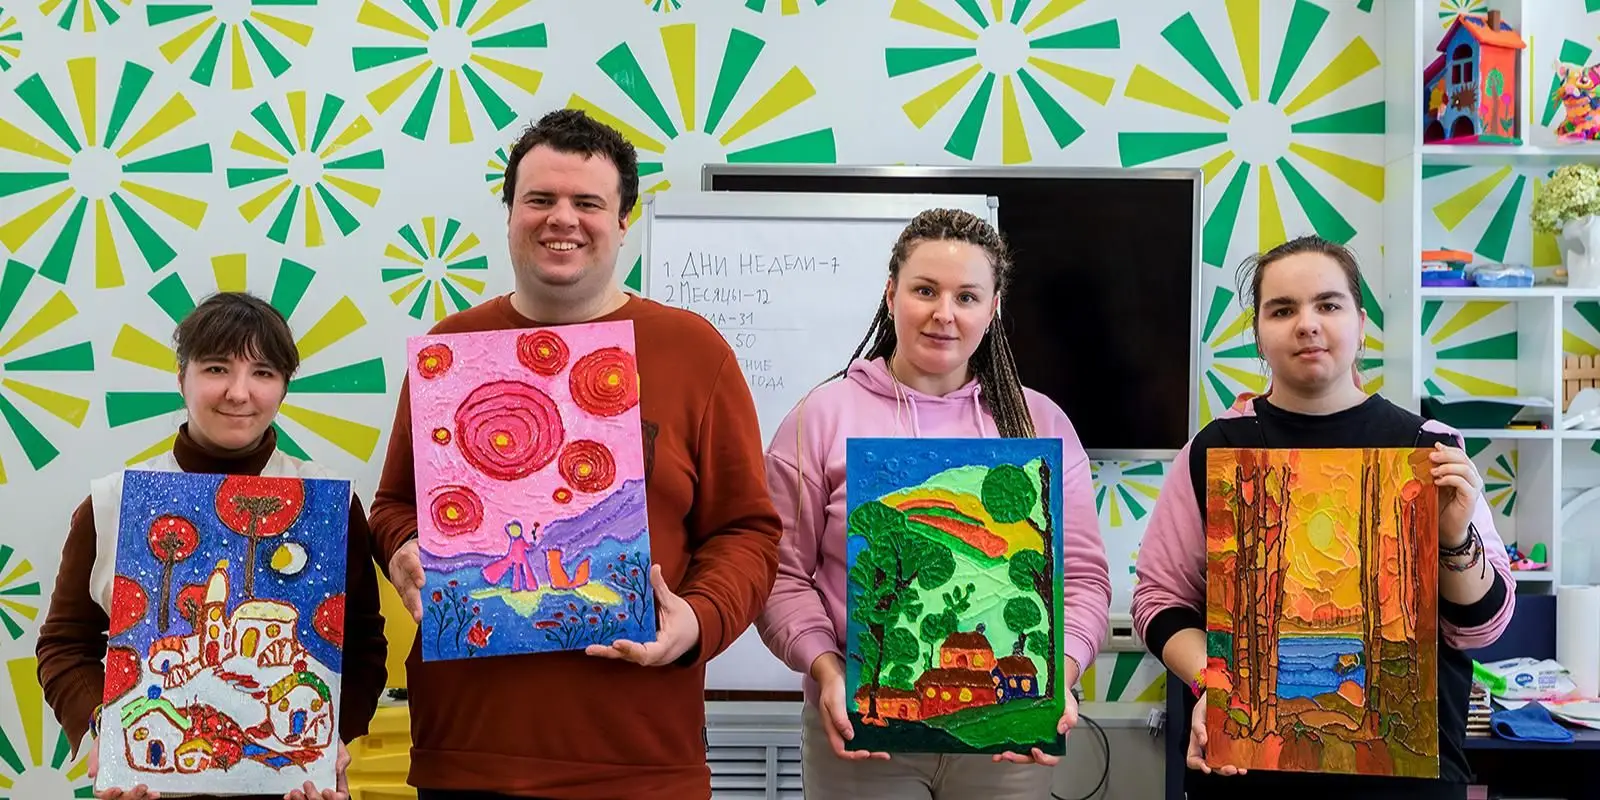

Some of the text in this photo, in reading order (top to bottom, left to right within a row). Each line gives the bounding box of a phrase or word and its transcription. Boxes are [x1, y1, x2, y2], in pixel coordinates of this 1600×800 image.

[680, 251, 728, 279] ДНИ
[735, 333, 757, 349] 50
[751, 374, 785, 391] ГОДА
